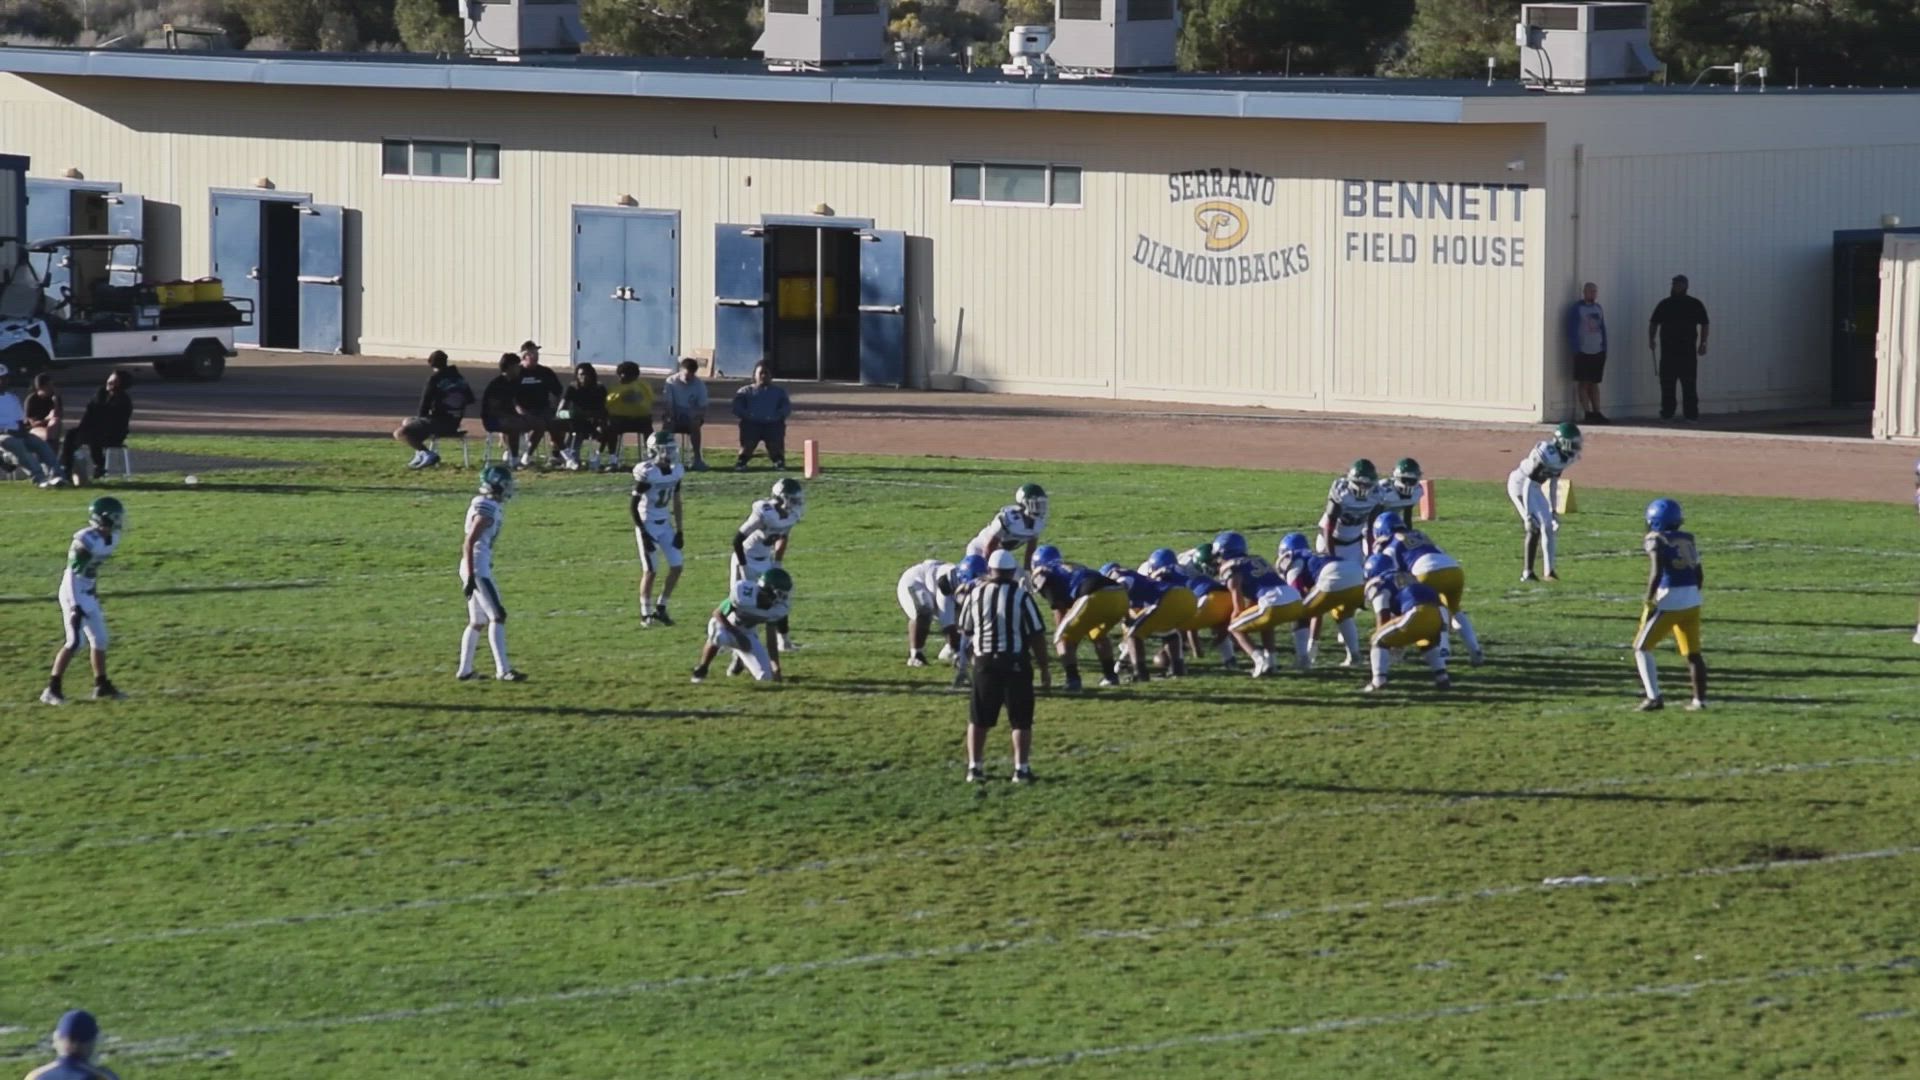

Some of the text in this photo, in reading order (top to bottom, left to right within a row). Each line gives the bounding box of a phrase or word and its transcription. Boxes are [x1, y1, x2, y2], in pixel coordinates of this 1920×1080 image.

[1168, 167, 1275, 206] SERRANO
[1342, 179, 1529, 222] BENNETT
[1132, 234, 1310, 286] DIAMONDBACKS
[1346, 232, 1525, 267] FIELD HOUSE
